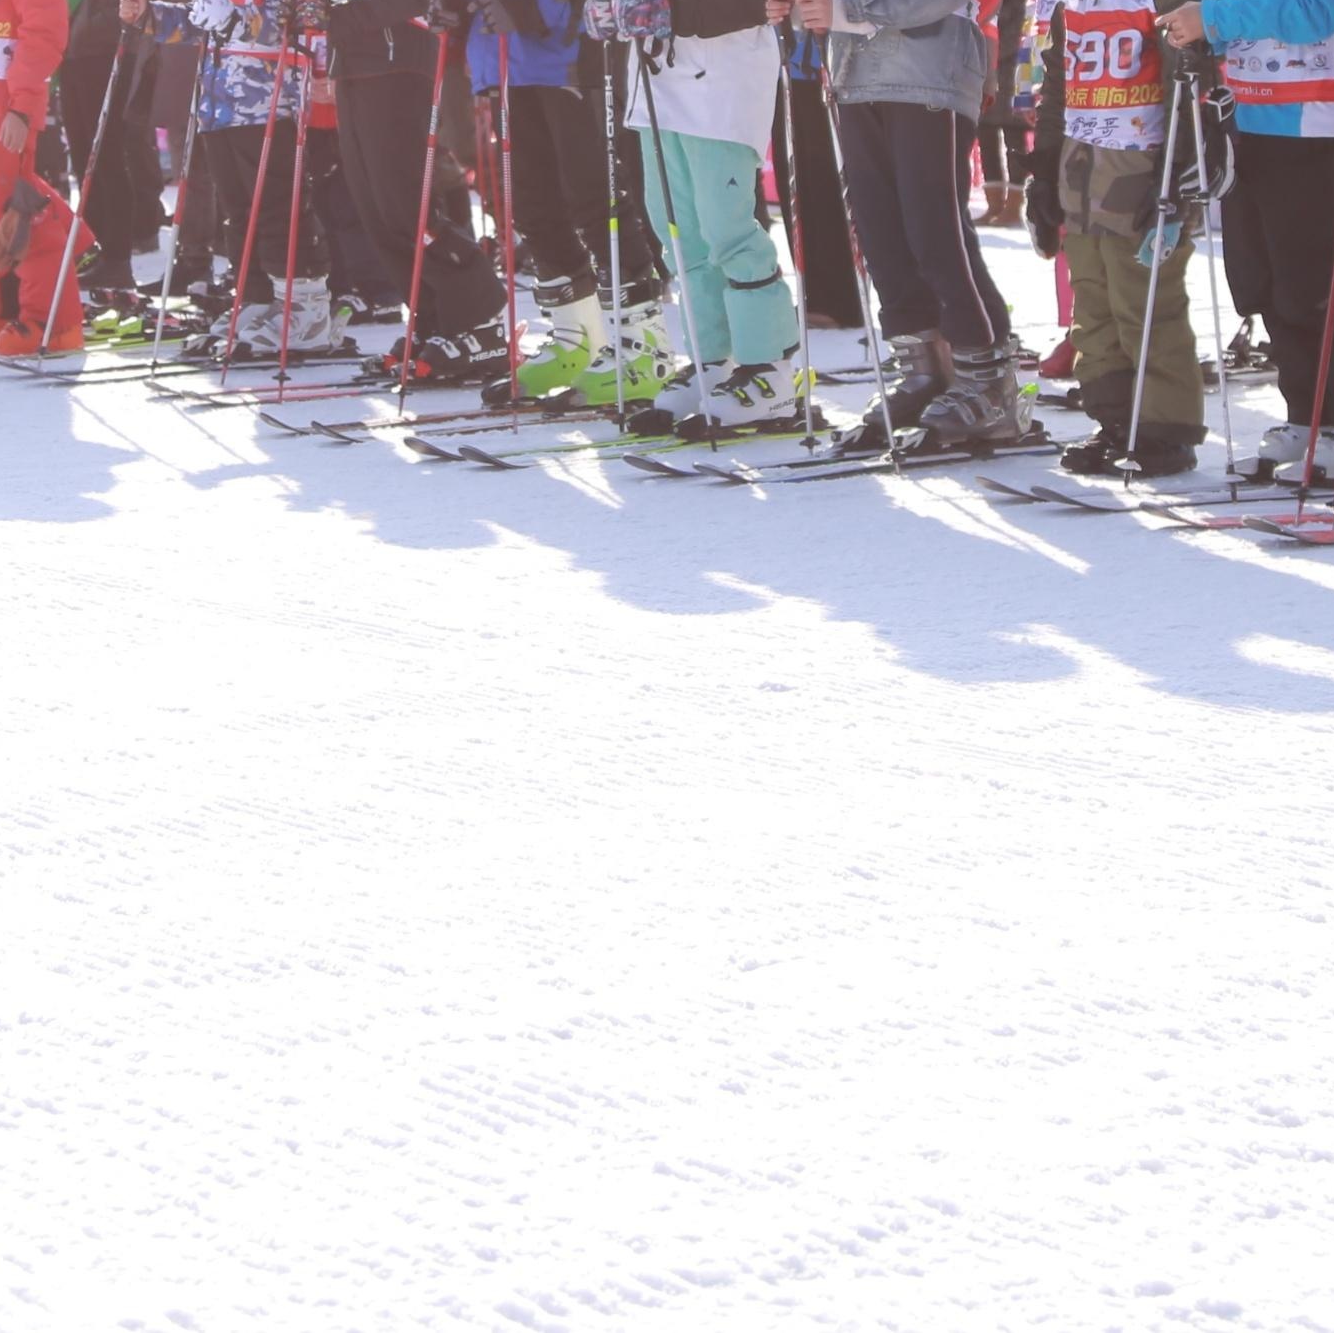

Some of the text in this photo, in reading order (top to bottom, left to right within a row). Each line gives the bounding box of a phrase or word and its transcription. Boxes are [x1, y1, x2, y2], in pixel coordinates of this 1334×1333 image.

[605, 75, 615, 138] HEAD
[469, 348, 508, 363] HEAD
[768, 397, 795, 412] HEAD
